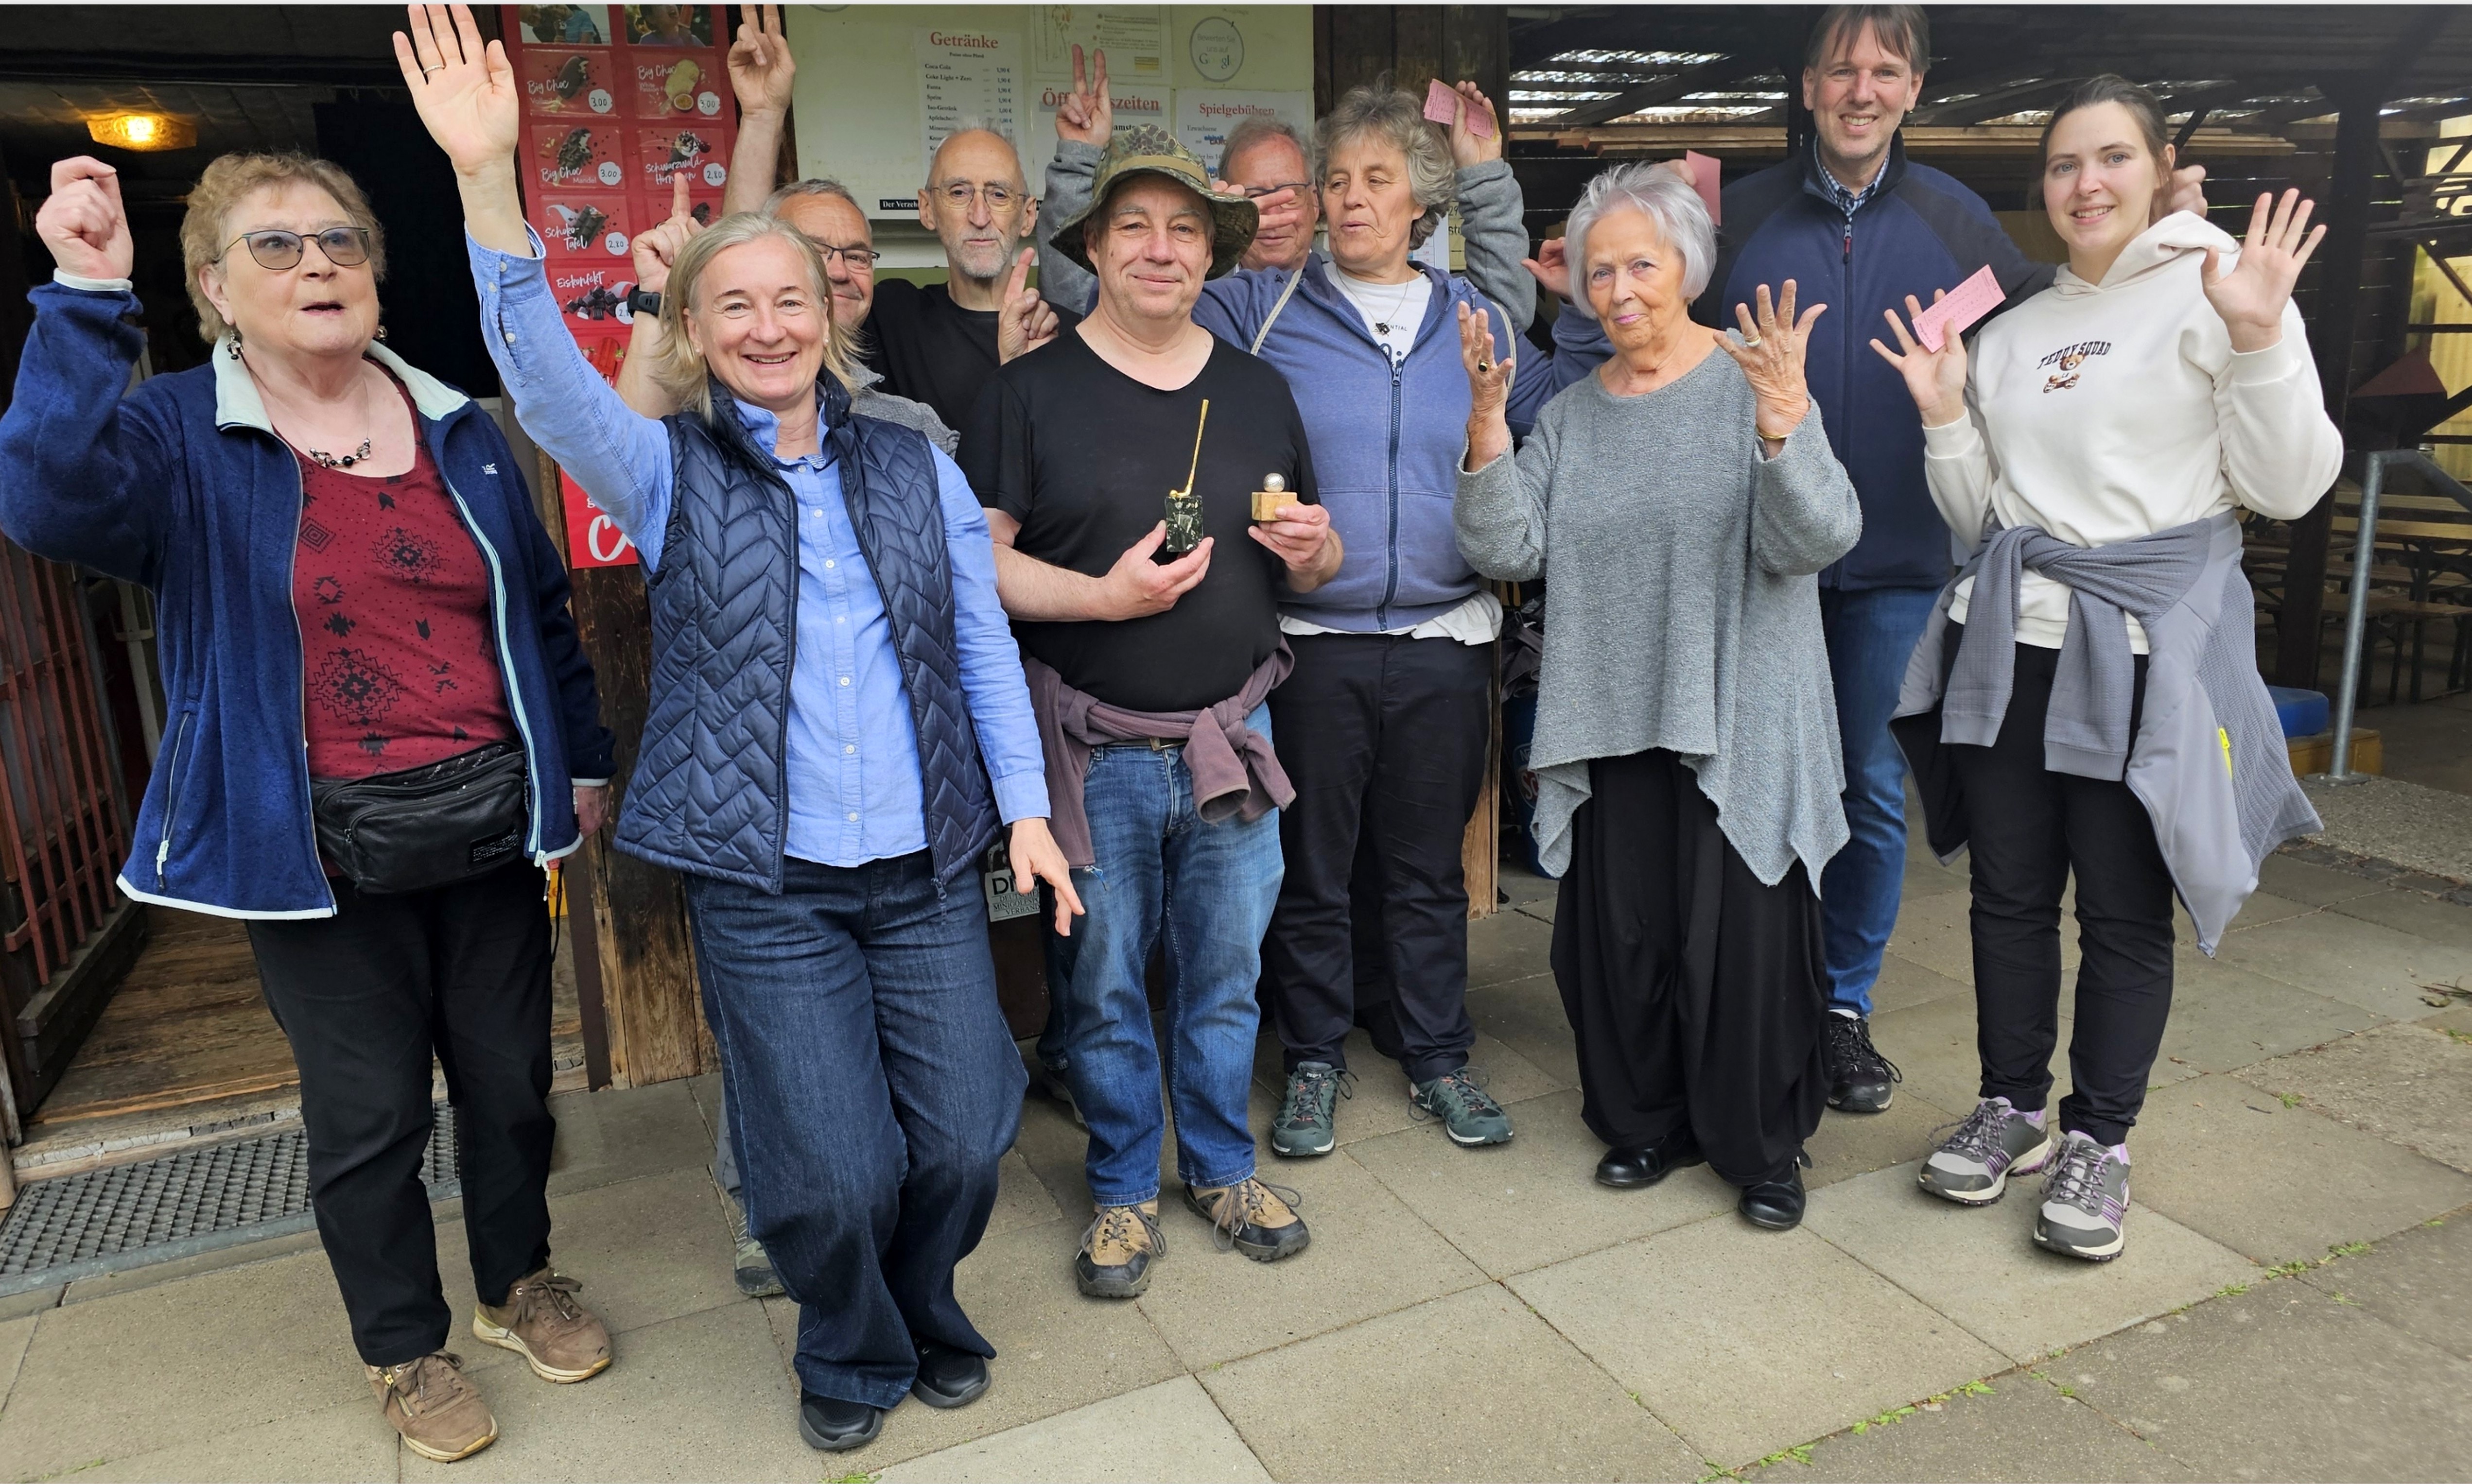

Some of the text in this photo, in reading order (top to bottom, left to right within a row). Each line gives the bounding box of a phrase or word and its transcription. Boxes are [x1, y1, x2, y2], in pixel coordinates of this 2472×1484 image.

[930, 32, 998, 49] Getränke
[637, 64, 677, 80] Big Choc
[527, 79, 569, 94] Big Choc
[1043, 87, 1159, 111] Öffszeiten
[645, 155, 704, 173] Schwarzwald-
[540, 166, 582, 182] Big Choc
[564, 235, 588, 251] Tafel
[557, 271, 605, 289] Eiskonfekt
[2037, 341, 2112, 370] TEDDY SQUAD
